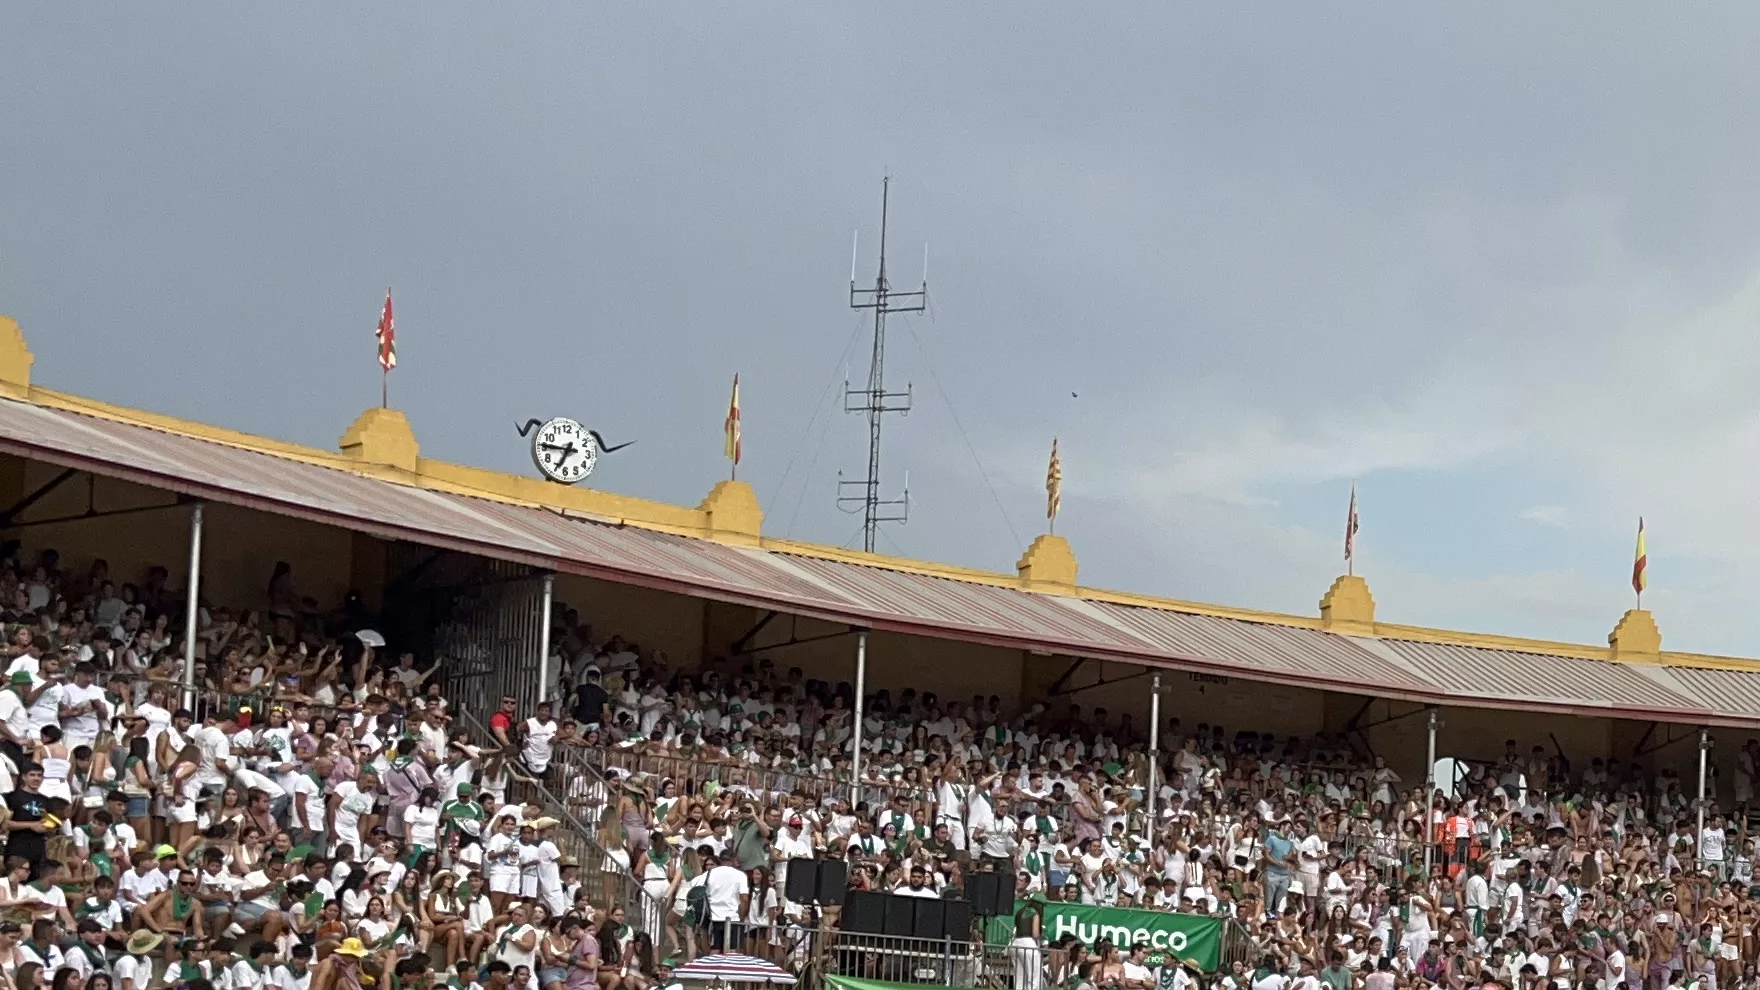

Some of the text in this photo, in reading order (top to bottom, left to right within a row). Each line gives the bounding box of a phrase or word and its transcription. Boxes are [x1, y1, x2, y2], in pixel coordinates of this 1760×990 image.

[552, 425, 562, 435] 11
[561, 424, 573, 434] 12
[544, 433, 555, 443] 10
[575, 430, 580, 440] 1
[581, 438, 588, 448] 2
[544, 453, 551, 463] 8
[584, 450, 591, 460] 3
[580, 460, 587, 470] 4
[562, 466, 569, 477] 6
[572, 465, 579, 476] 5
[1055, 914, 1188, 951] Humeco
